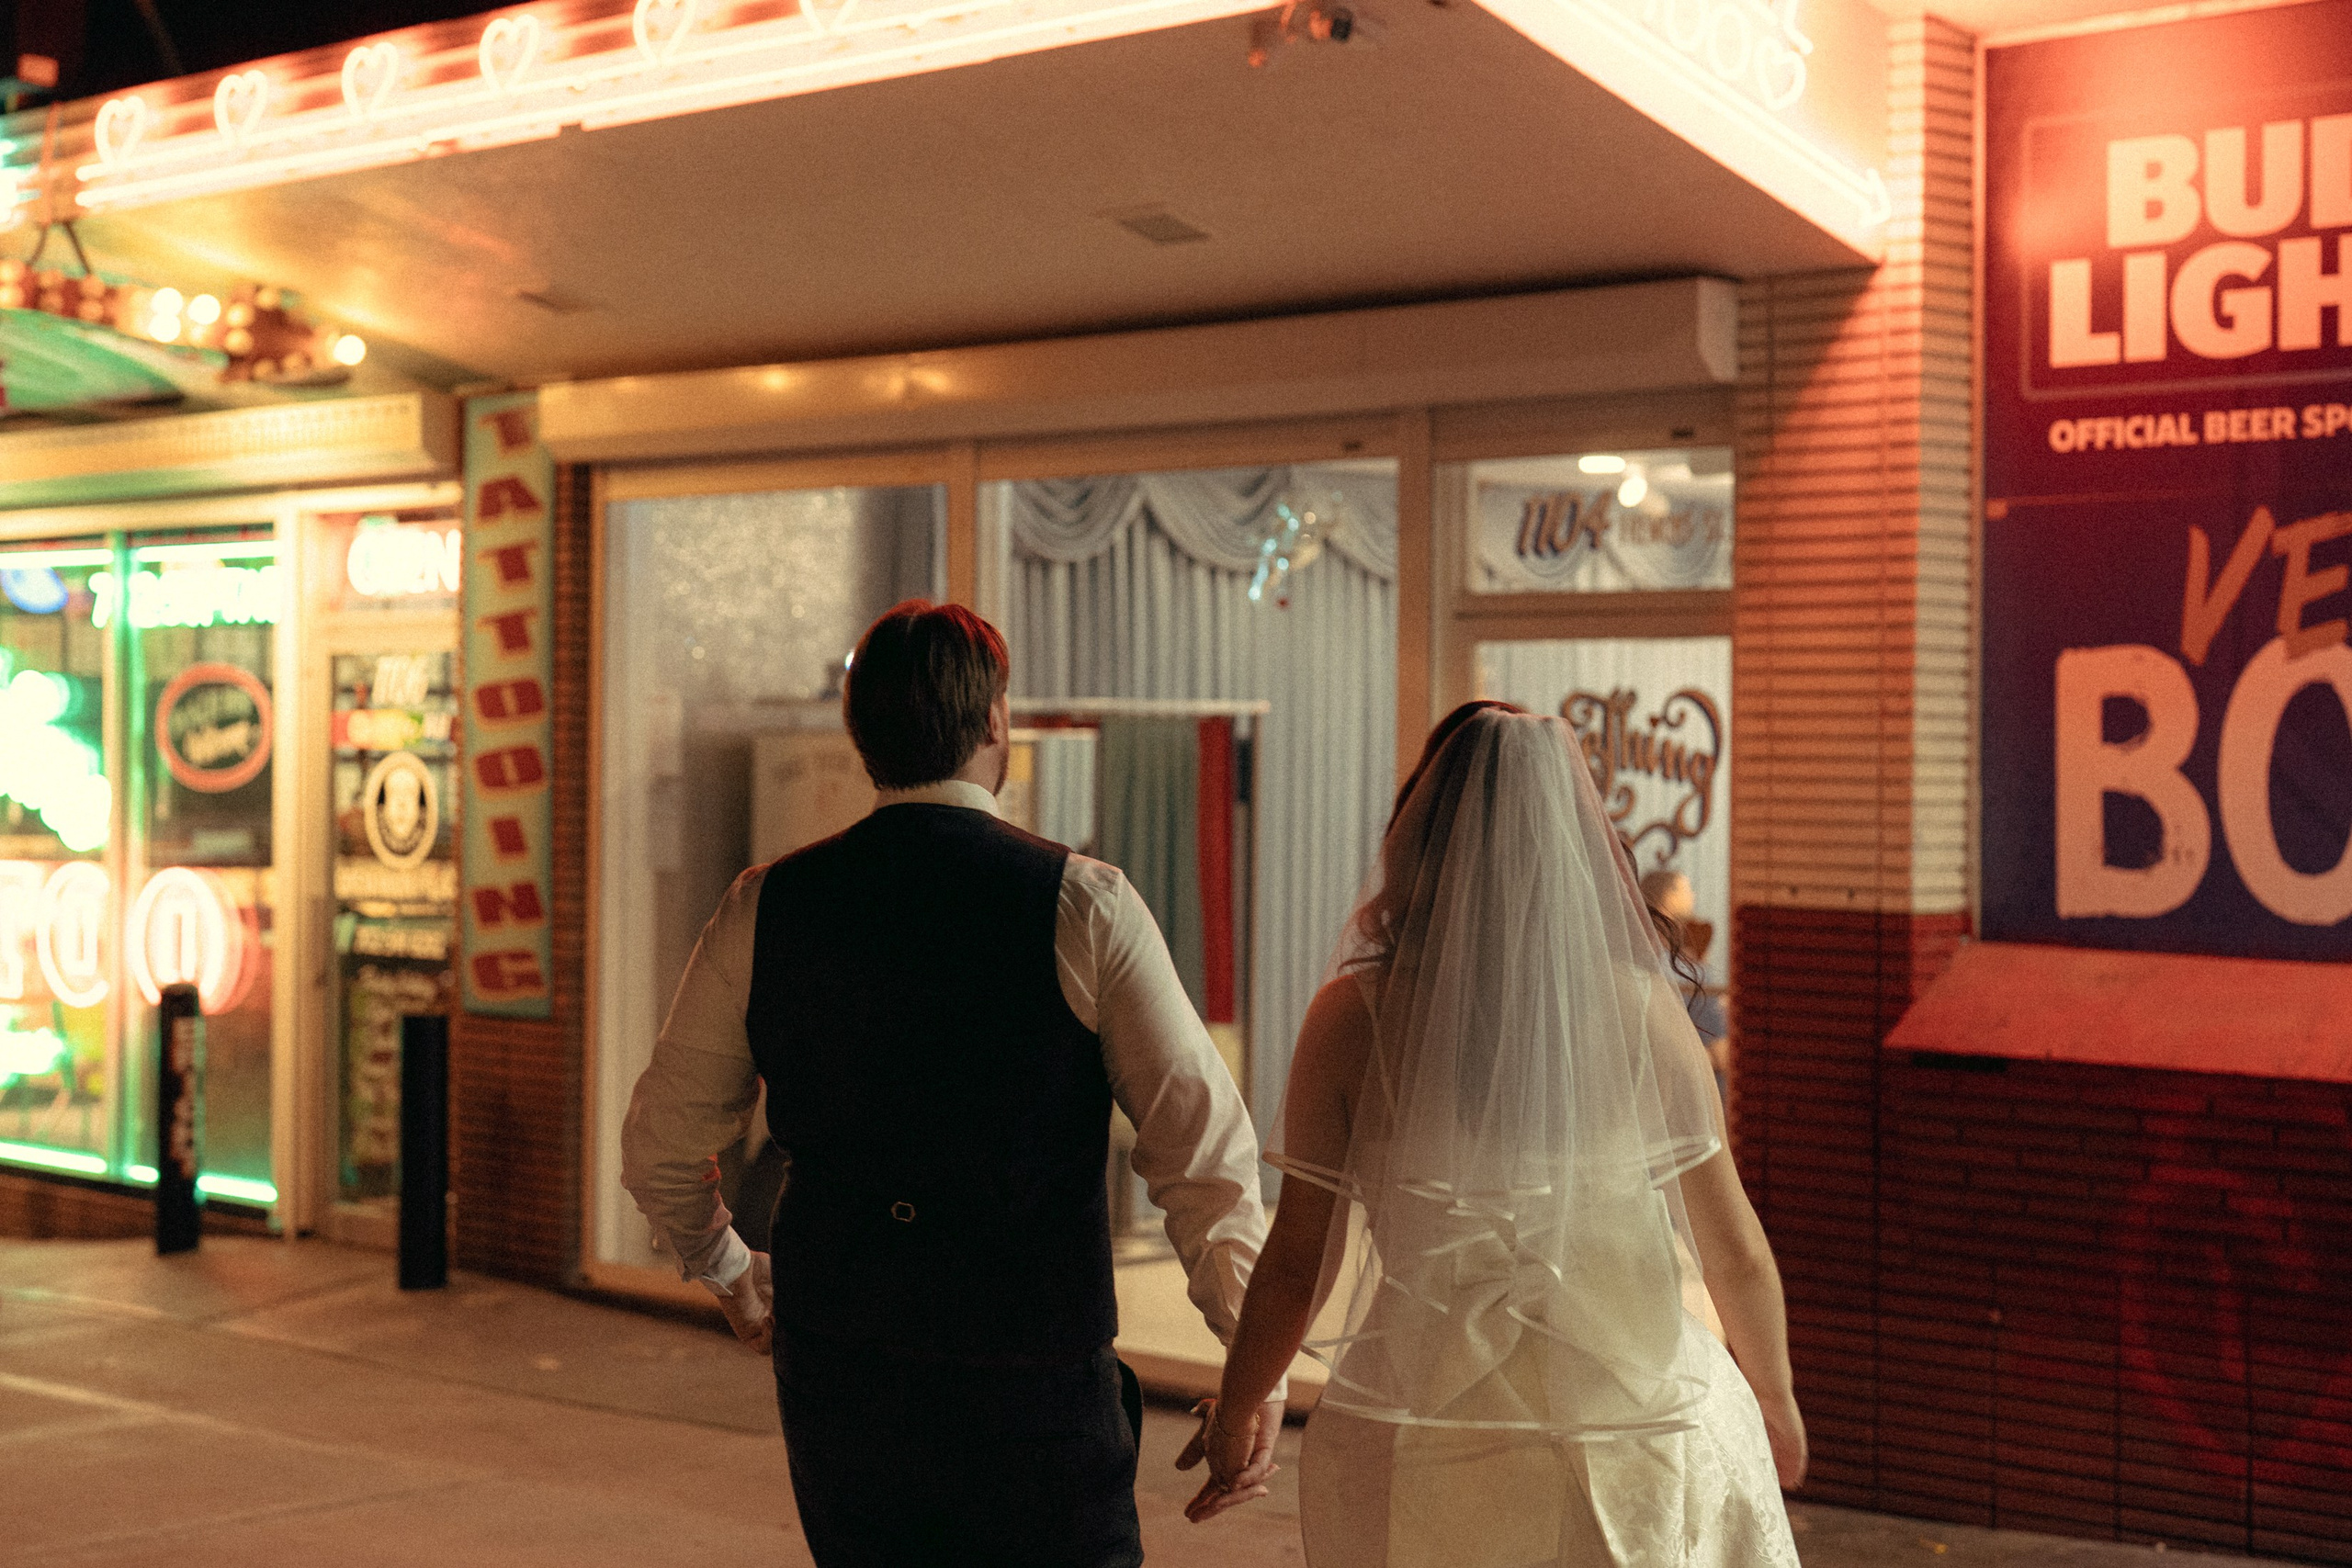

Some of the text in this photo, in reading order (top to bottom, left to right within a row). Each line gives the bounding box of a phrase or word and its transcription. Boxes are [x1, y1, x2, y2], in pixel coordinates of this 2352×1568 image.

[2048, 402, 2352, 454] OFFICIAL BEER SP
[474, 402, 549, 1003] TATTOOING
[2054, 637, 2352, 927] BO
